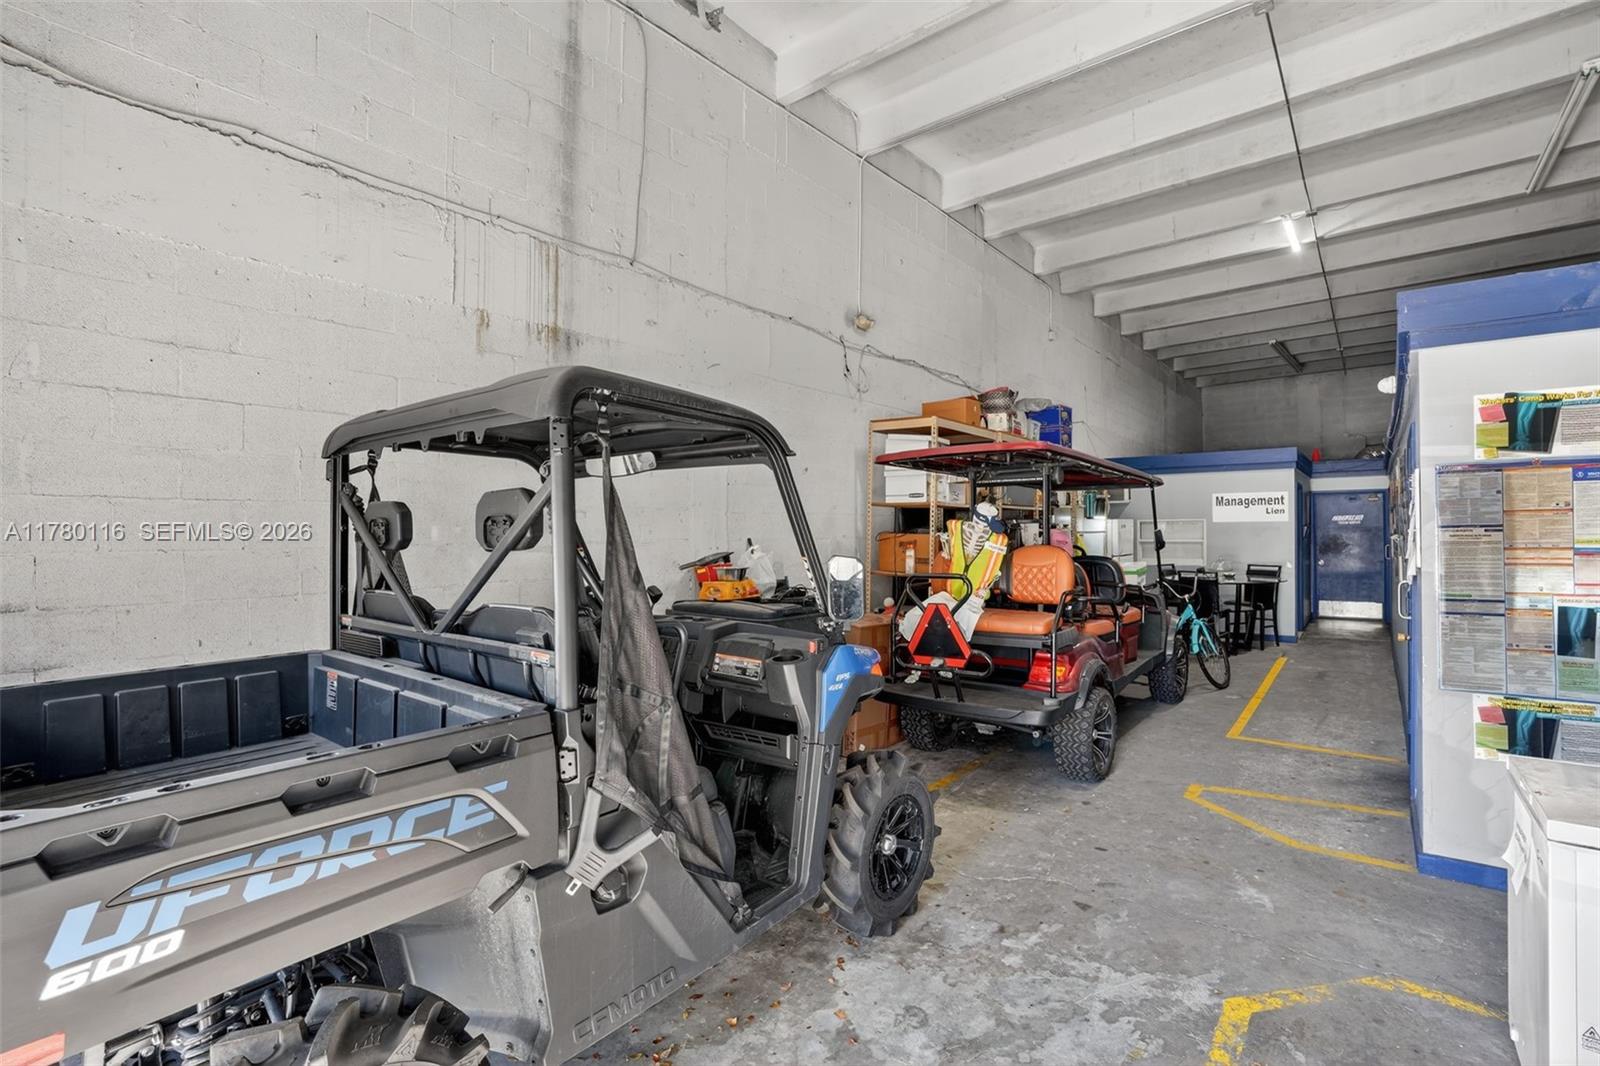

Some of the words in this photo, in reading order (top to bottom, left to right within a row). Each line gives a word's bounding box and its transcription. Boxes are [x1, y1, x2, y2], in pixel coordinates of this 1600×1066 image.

[1519, 395, 1545, 403] Comp
[1546, 392, 1576, 400] Works
[1215, 495, 1285, 508] Management
[1265, 507, 1285, 515] Lien
[43, 780, 508, 970] UFORCE
[39, 928, 186, 1002] 600
[571, 965, 678, 1045] CFMOTO
